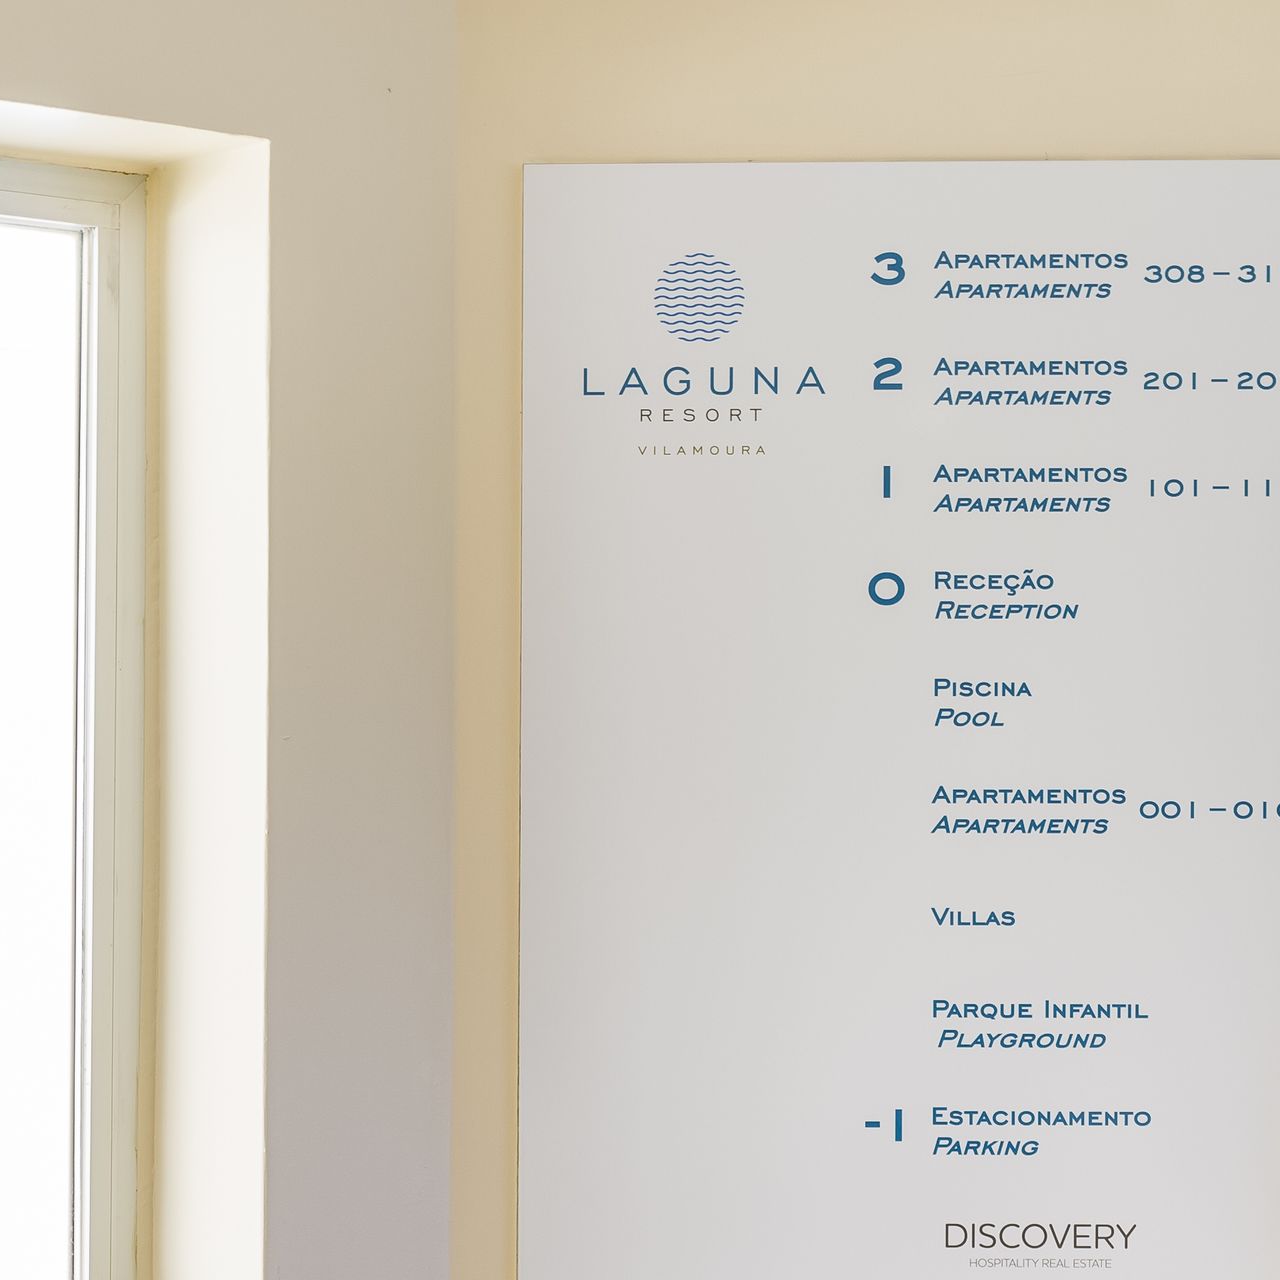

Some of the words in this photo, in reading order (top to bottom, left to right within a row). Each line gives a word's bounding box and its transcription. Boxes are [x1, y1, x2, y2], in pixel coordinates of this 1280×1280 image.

[870, 252, 905, 286] 3
[933, 251, 1128, 270] APARTAMENTOS
[933, 280, 1113, 299] APARTAMENTS
[872, 357, 904, 391] 2
[933, 357, 1128, 376] APARTAMENTOS
[583, 366, 826, 396] LAGUNA
[932, 387, 1113, 406] APARTAMENTS
[639, 408, 763, 423] RESORT
[637, 445, 766, 456] VILAMOURA
[933, 464, 1128, 483] APARTAMENTOS
[932, 494, 1112, 513] APARTAMENTS
[933, 568, 1055, 597] RECEÇÃO
[934, 600, 1080, 620] RECEPTION
[933, 677, 1033, 698] PISCINA
[934, 708, 1005, 728] POOL
[931, 785, 1127, 805] APARTAMENTOS
[930, 815, 1110, 835] APARTAMENTS
[930, 908, 1016, 928] VILLAS
[932, 1000, 1033, 1022] PARQUE
[1044, 1000, 1150, 1019] INFANTIL
[937, 1029, 1107, 1049] PLAYGROUND
[932, 1107, 1152, 1127] ESTACIONAMENTO
[932, 1136, 1040, 1157] PARKING
[944, 1223, 1137, 1250] DISCOVERY
[969, 1258, 1040, 1269] HOSPITALITY
[1041, 1258, 1070, 1269] REAL
[1072, 1258, 1112, 1269] ESTATE
